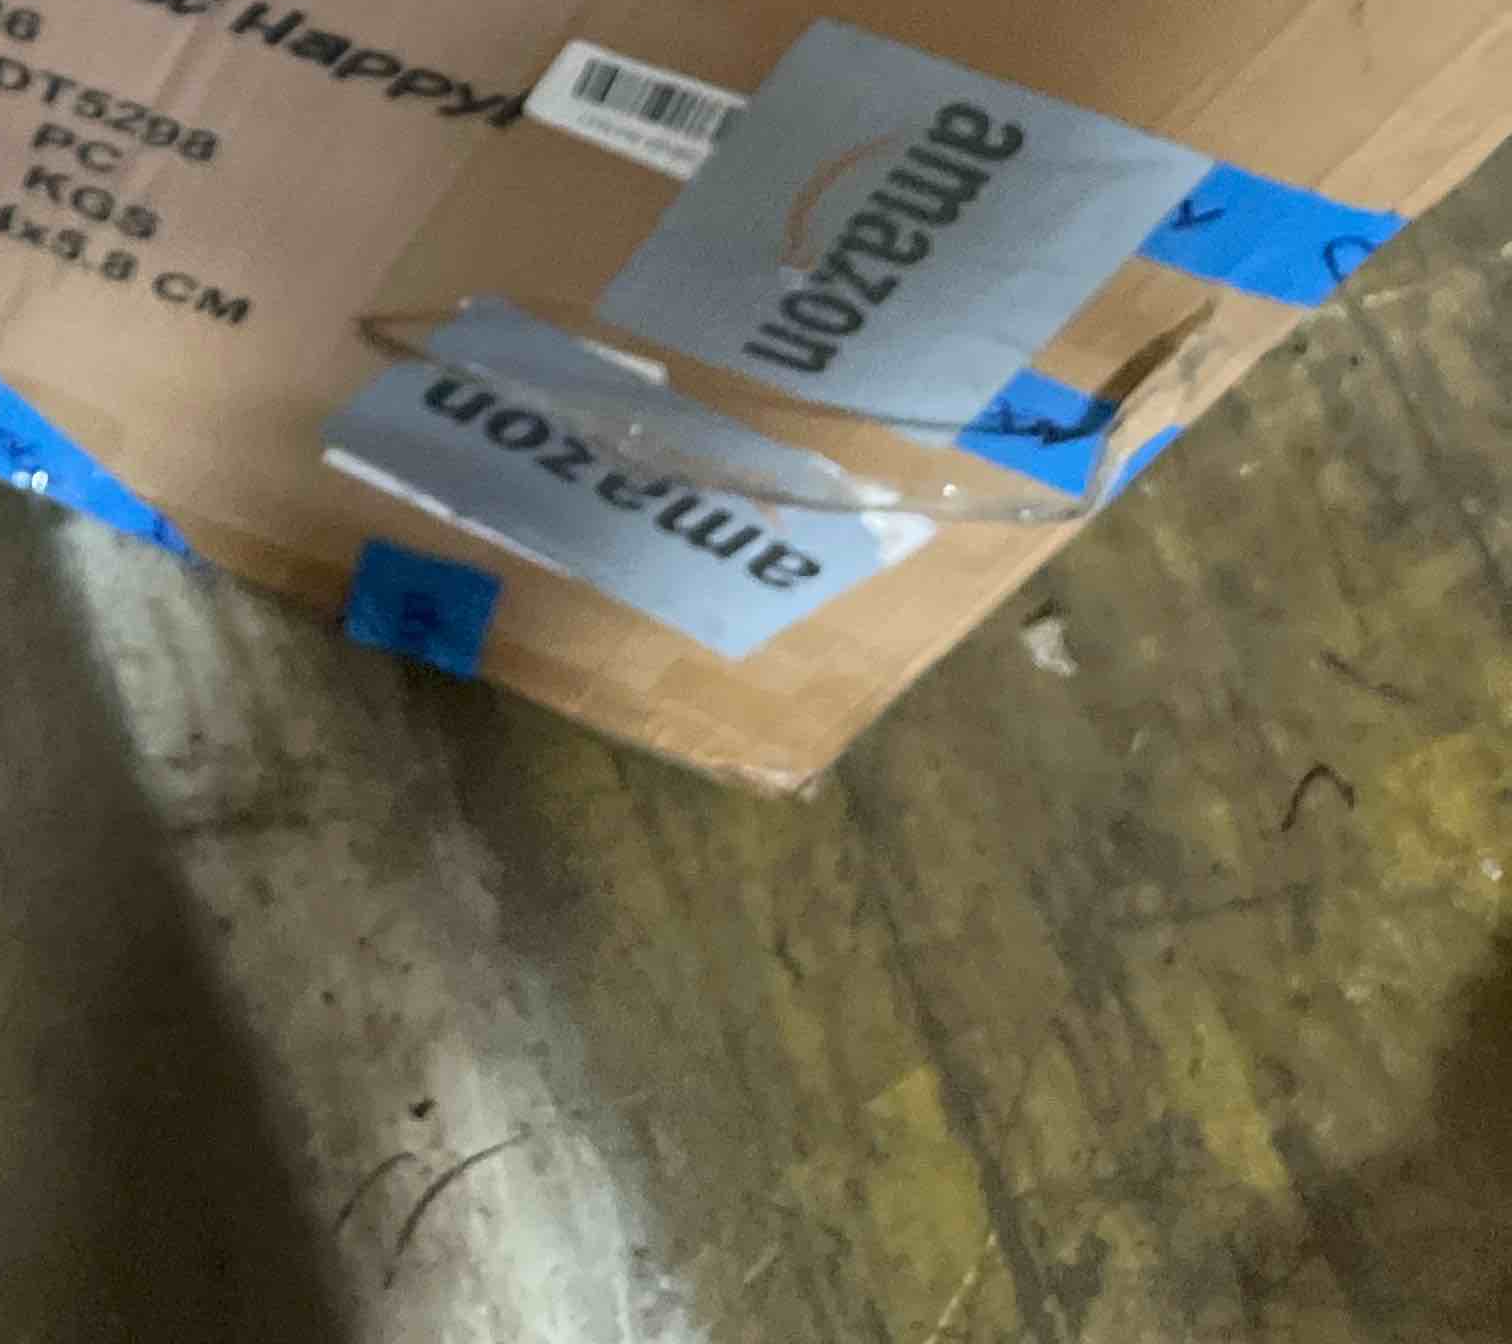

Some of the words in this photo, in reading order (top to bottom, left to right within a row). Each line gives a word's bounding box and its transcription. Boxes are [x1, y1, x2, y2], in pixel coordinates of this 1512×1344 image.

[31, 122, 125, 174] PC
[23, 166, 161, 240] KGS
[741, 101, 1027, 375] amazon
[151, 270, 252, 325] CM
[422, 374, 825, 591] amazon
